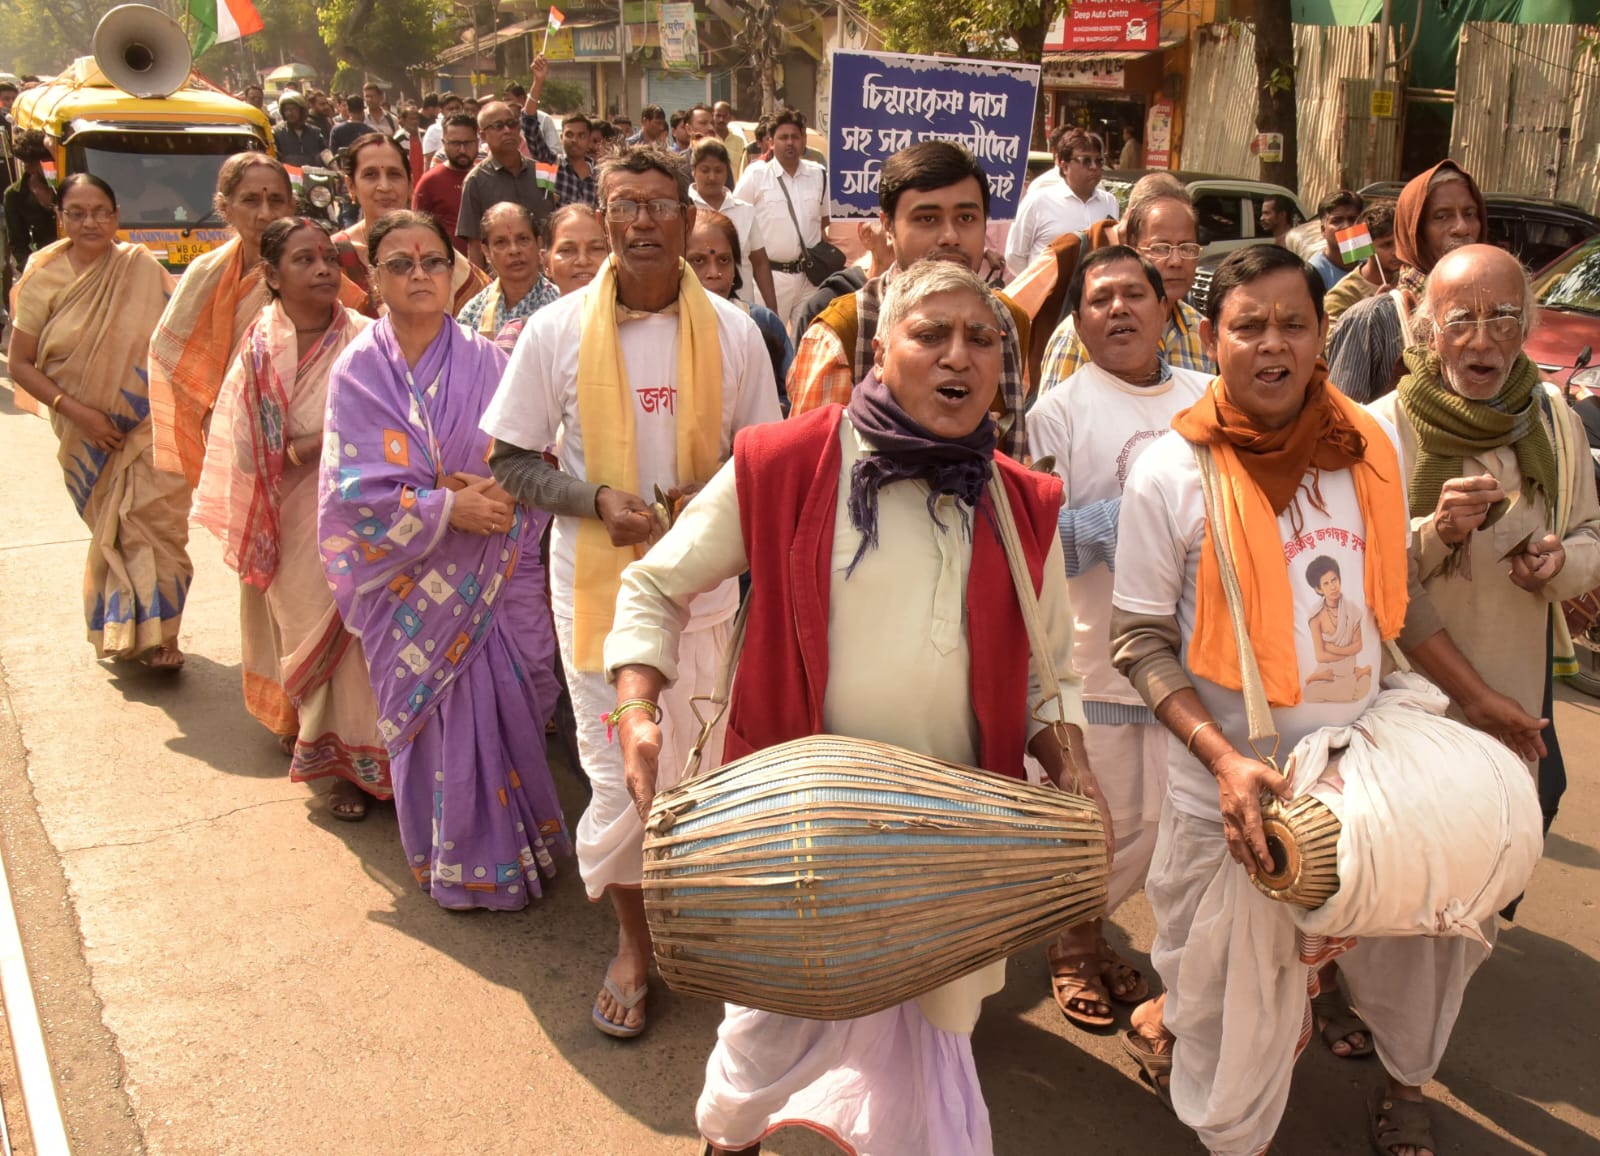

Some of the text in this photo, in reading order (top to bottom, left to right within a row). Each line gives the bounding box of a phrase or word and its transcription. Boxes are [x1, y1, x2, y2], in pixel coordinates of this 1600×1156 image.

[1074, 10, 1090, 20] Deep
[1091, 10, 1106, 18] Auto
[580, 31, 615, 51] VOLTAS
[969, 91, 1008, 121] দাস
[841, 125, 873, 156] সহ
[177, 244, 188, 254] WB
[636, 385, 677, 416] জগ
